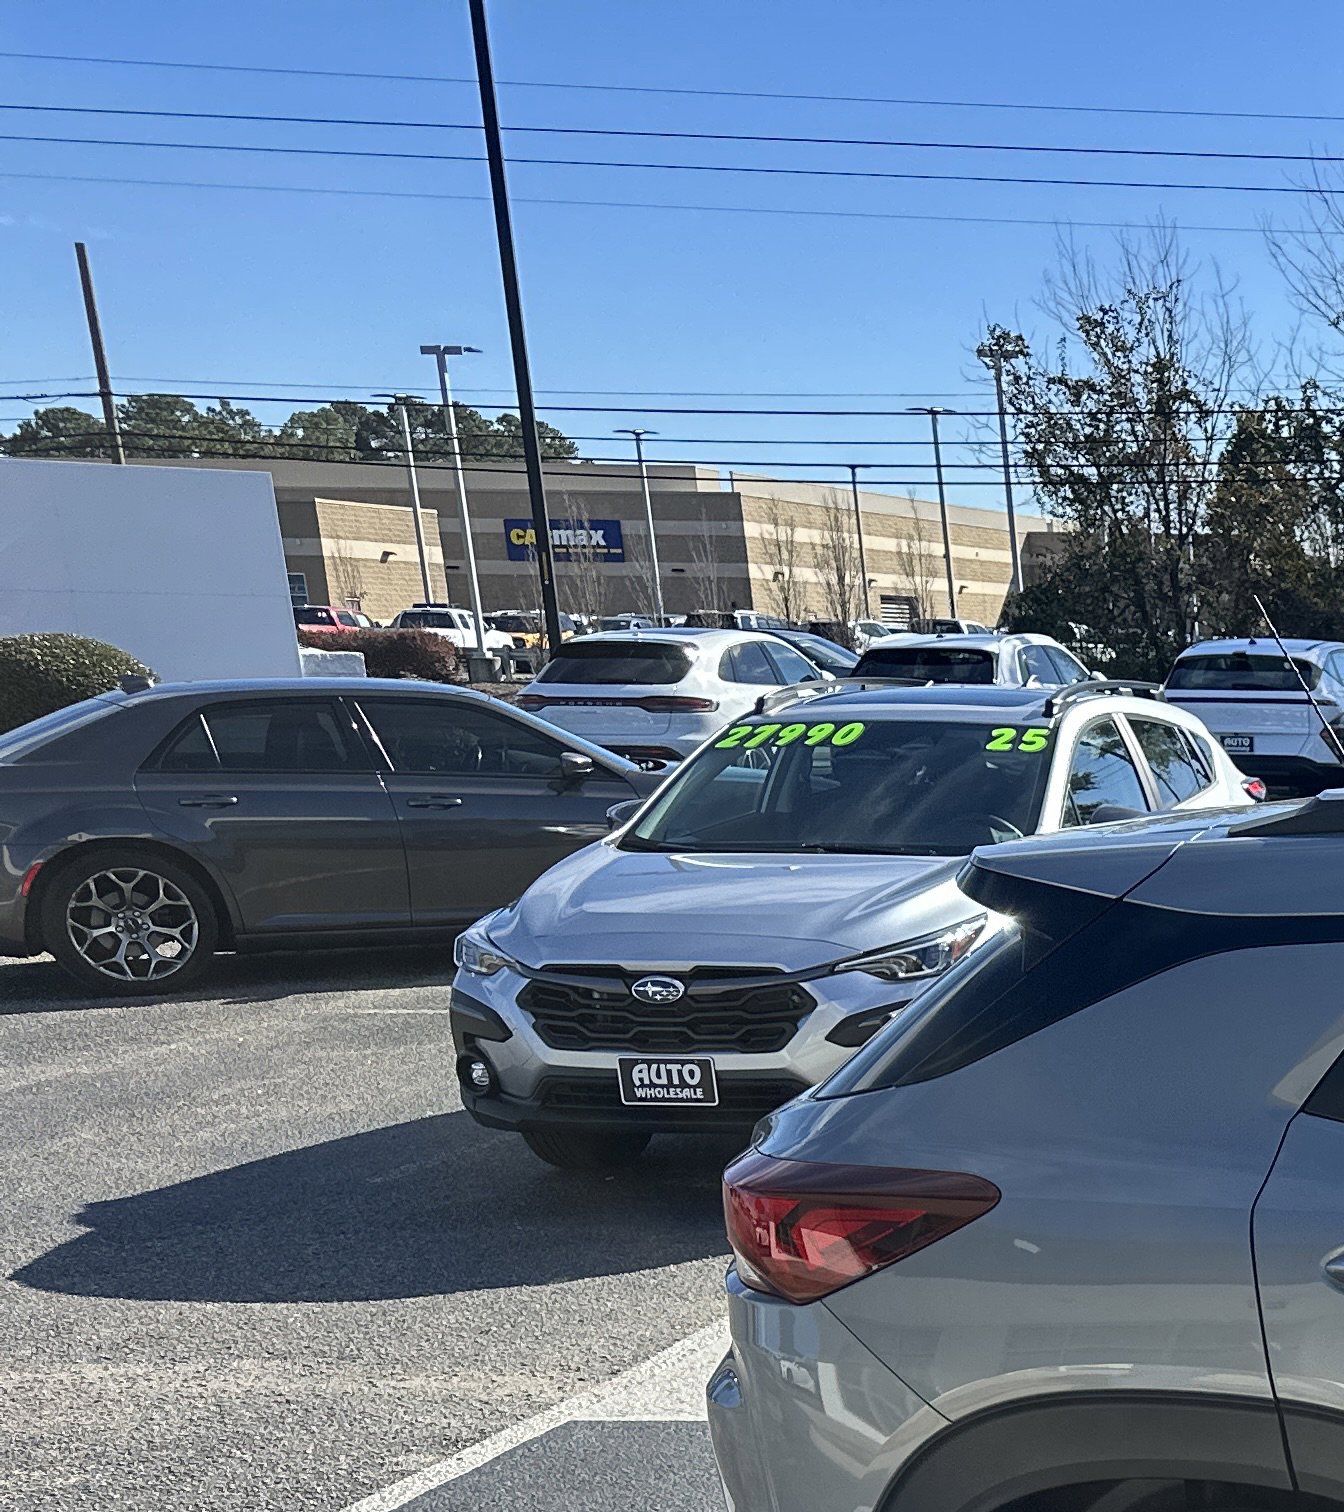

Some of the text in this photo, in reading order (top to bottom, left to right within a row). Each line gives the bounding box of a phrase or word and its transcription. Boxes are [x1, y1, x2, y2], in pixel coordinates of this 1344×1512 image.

[509, 528, 607, 546] CAmax
[714, 722, 866, 749] 27990
[985, 727, 1051, 753] 25
[1223, 737, 1251, 747] AUTO
[631, 1063, 702, 1087] AUTO
[634, 1086, 704, 1099] WHOLESALE
